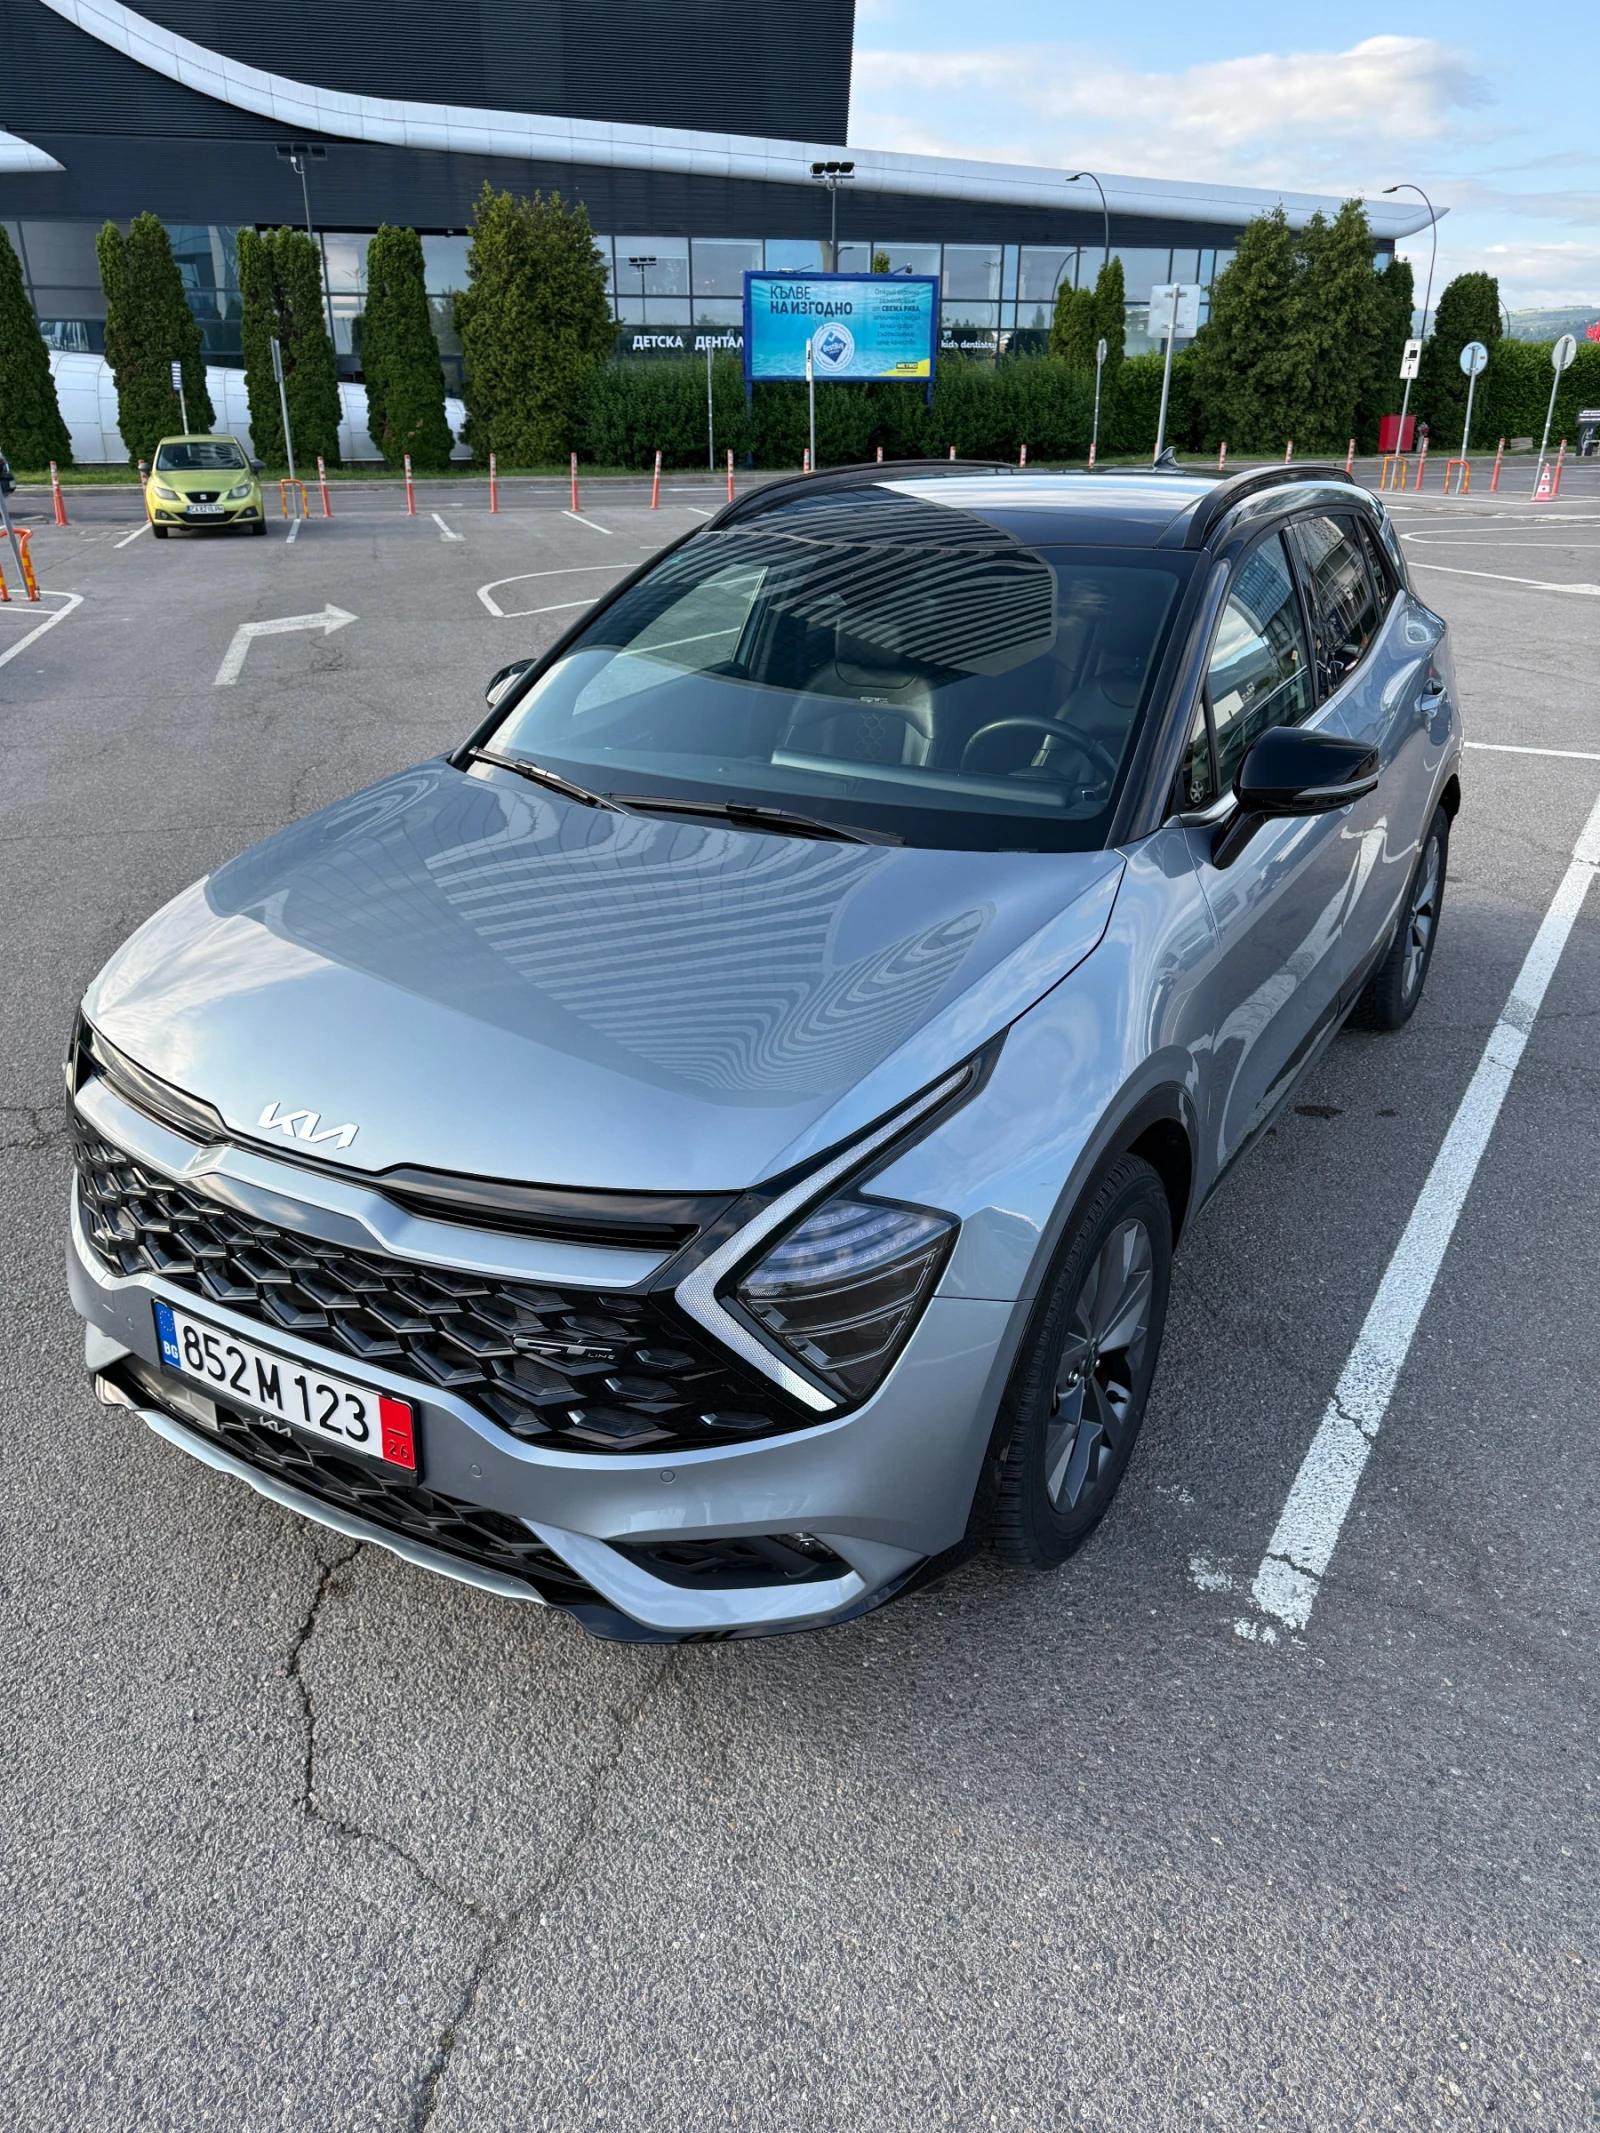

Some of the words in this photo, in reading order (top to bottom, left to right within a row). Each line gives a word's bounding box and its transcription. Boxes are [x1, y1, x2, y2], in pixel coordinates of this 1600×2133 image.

[770, 286, 811, 300] КЪЛВЕ
[770, 301, 789, 315] НА
[791, 301, 853, 317] ИЗГОДНО
[632, 335, 684, 350] ДЕТСКА
[941, 340, 959, 348] kids
[960, 340, 997, 352] dentistry
[163, 1340, 179, 1360] BG
[183, 1325, 251, 1396] 852
[255, 1357, 283, 1411] M
[294, 1375, 370, 1443] 123
[388, 1439, 410, 1460] 26
